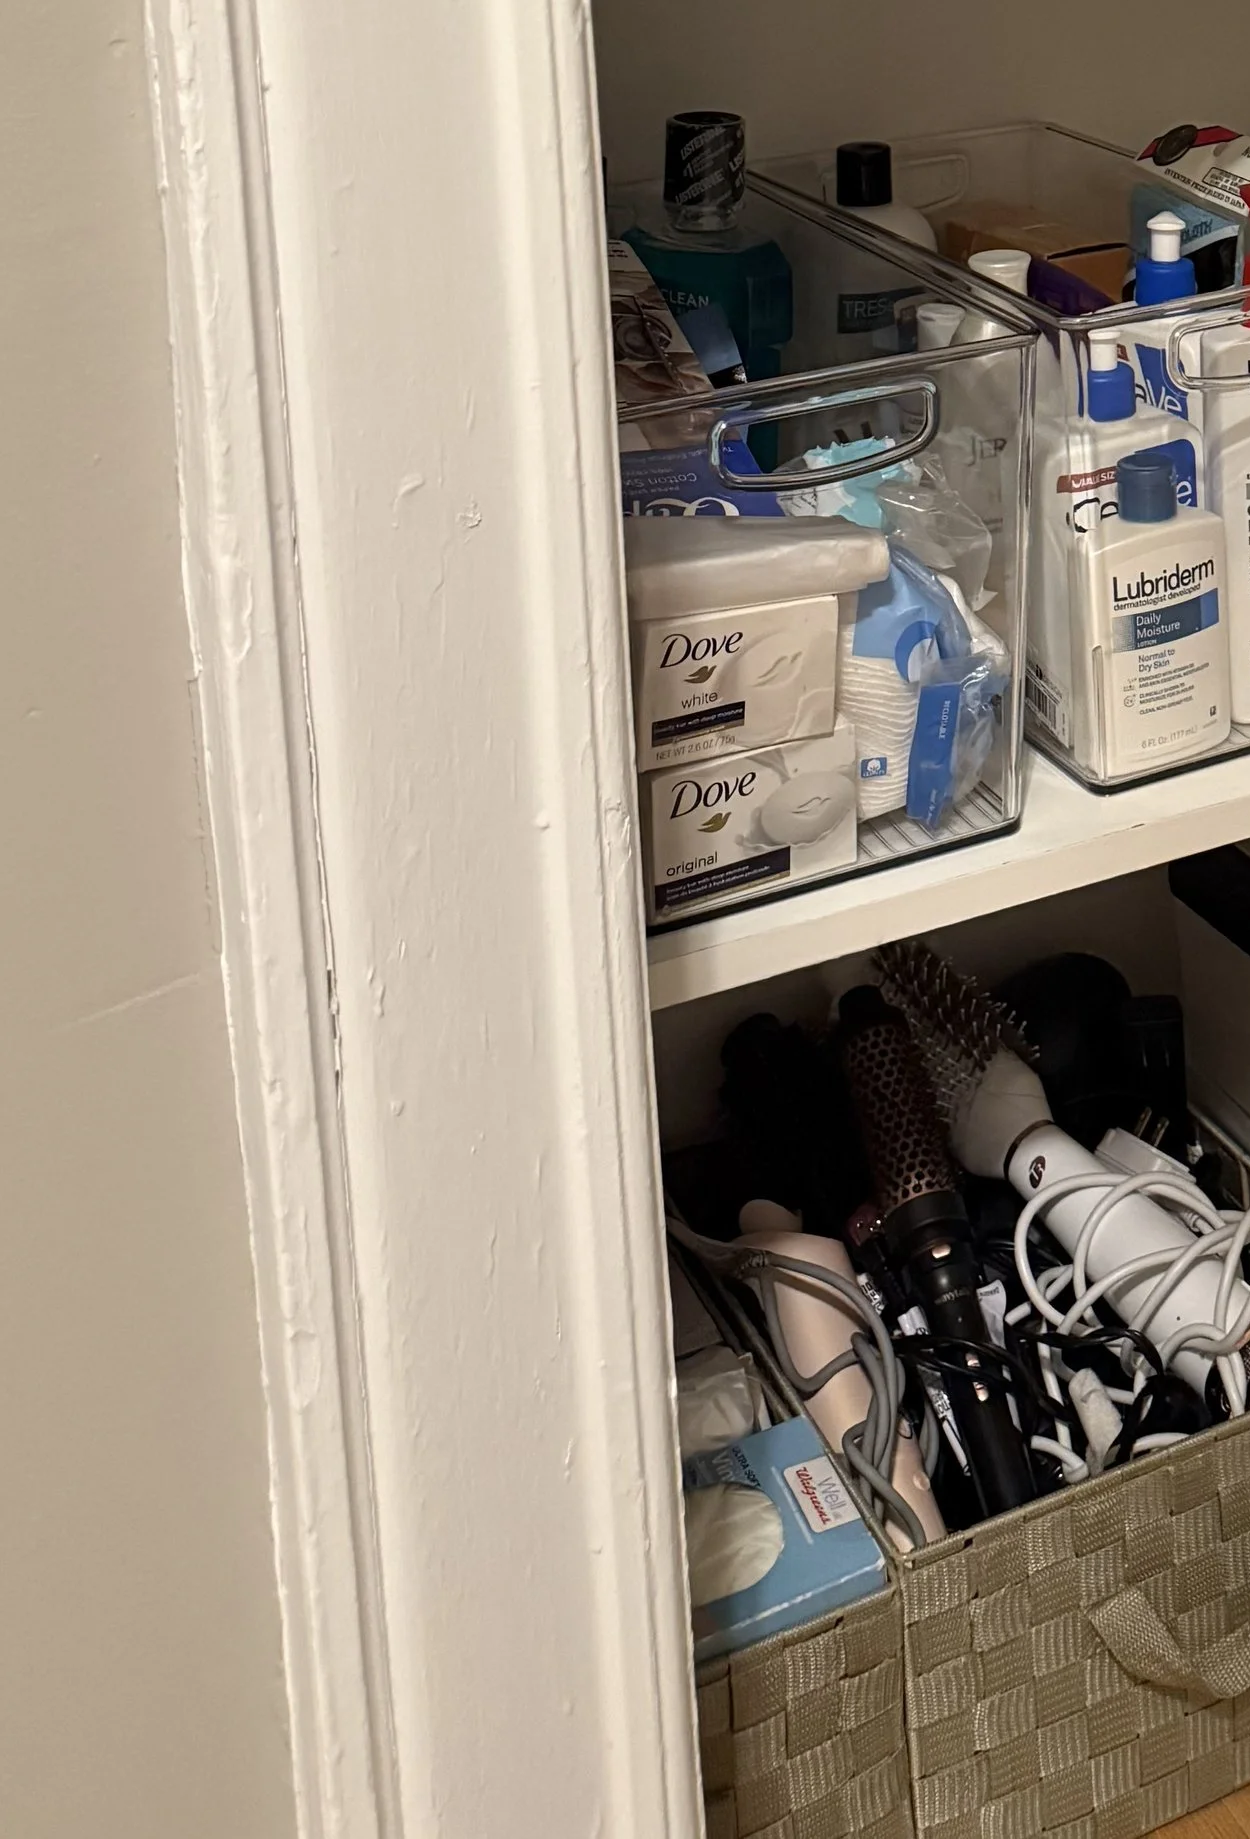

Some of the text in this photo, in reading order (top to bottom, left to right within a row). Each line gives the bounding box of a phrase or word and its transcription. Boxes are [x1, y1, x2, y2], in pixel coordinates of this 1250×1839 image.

[661, 289, 710, 307] CLEAN
[843, 297, 892, 318] TRES
[1101, 470, 1118, 482] SIZ
[1112, 558, 1215, 602] Lubriderm
[1114, 584, 1201, 611] dermatologist developed
[1136, 612, 1162, 626] Daily
[1136, 620, 1181, 640] Moisture
[660, 631, 744, 669] Dove
[1138, 648, 1176, 663] Normal to
[1138, 663, 1153, 673] Dry
[1153, 659, 1170, 670] Skin
[681, 691, 719, 710] white
[670, 771, 756, 820] Dove
[666, 851, 718, 878] original
[732, 1446, 748, 1470] ULTRA
[795, 1467, 832, 1526] Walgreens
[818, 1476, 848, 1511] Well
